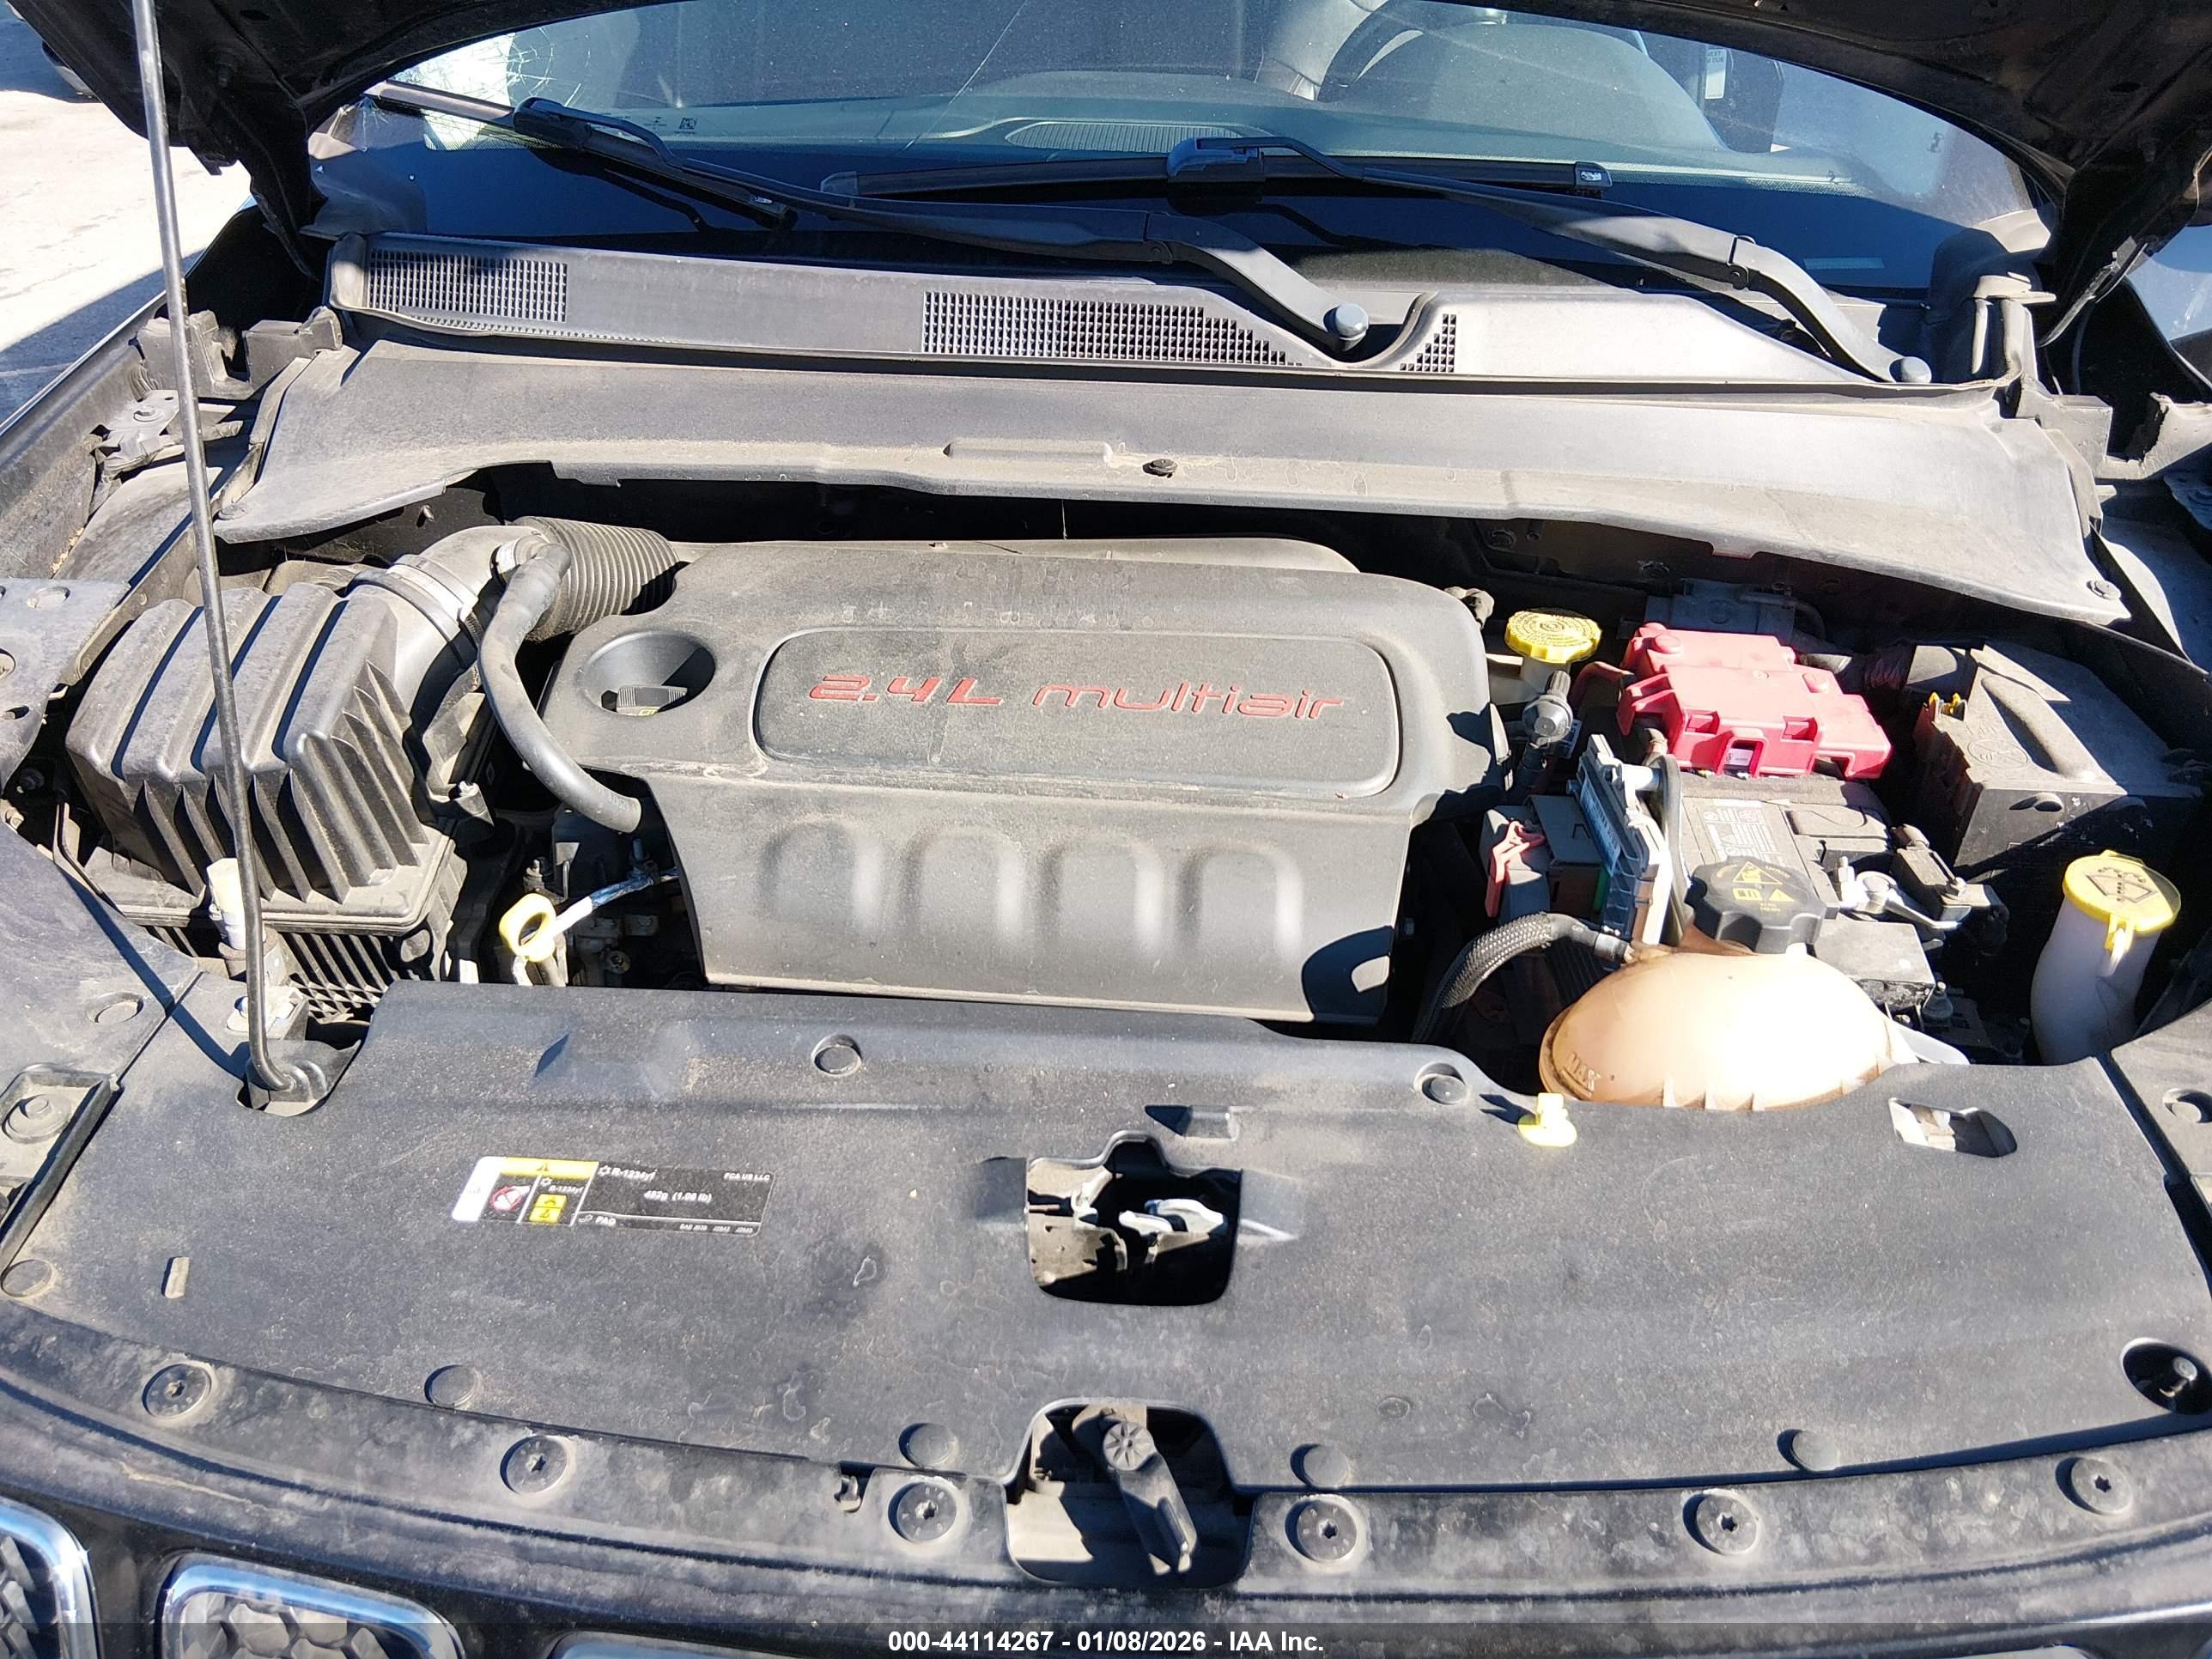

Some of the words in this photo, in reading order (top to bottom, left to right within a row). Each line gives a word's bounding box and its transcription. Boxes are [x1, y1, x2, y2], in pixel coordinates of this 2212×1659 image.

[809, 675, 1004, 706] 2.4L
[1032, 681, 1346, 720] multiair
[611, 1167, 659, 1182] R-1234yf
[753, 1174, 771, 1183] LLC
